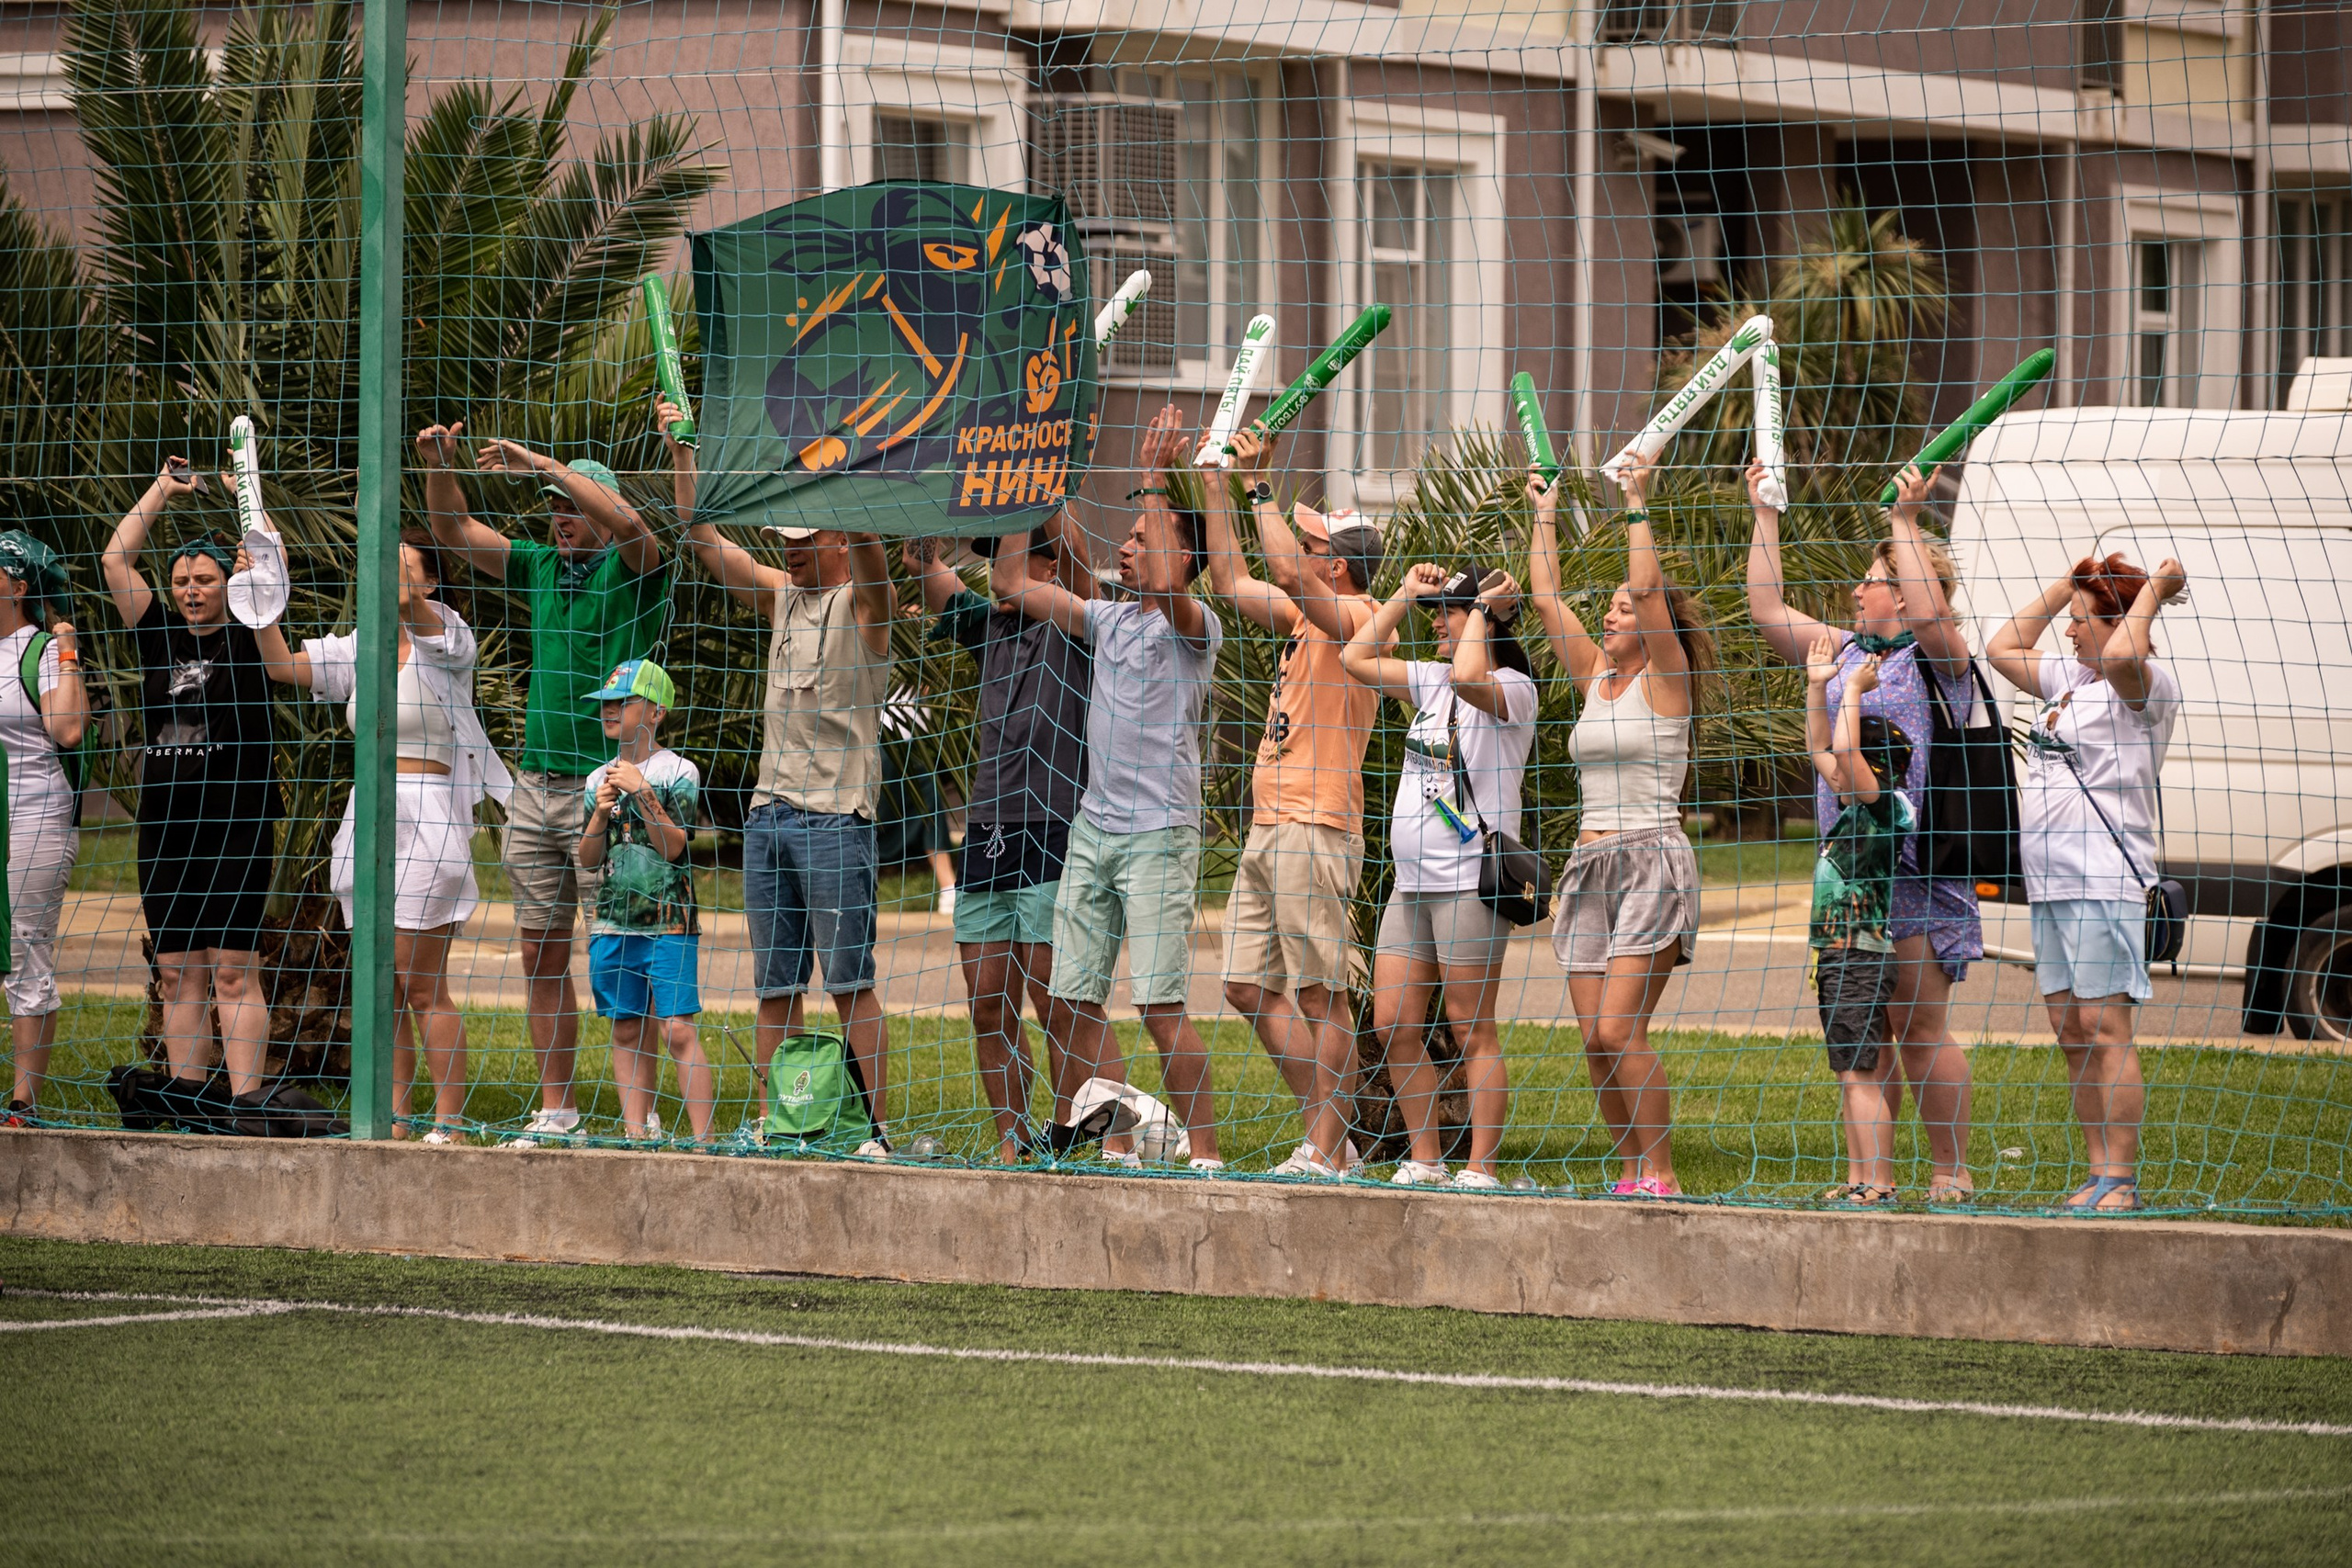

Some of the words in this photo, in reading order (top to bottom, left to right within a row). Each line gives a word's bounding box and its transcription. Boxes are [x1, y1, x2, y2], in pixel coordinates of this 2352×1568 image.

[1234, 348, 1254, 375] ДАЙ
[1695, 355, 1728, 391] ДАЙ
[1219, 378, 1242, 413] ПЯТЬ!
[1654, 388, 1699, 433] ПЯТЬ!
[234, 460, 252, 492] ДАЙ
